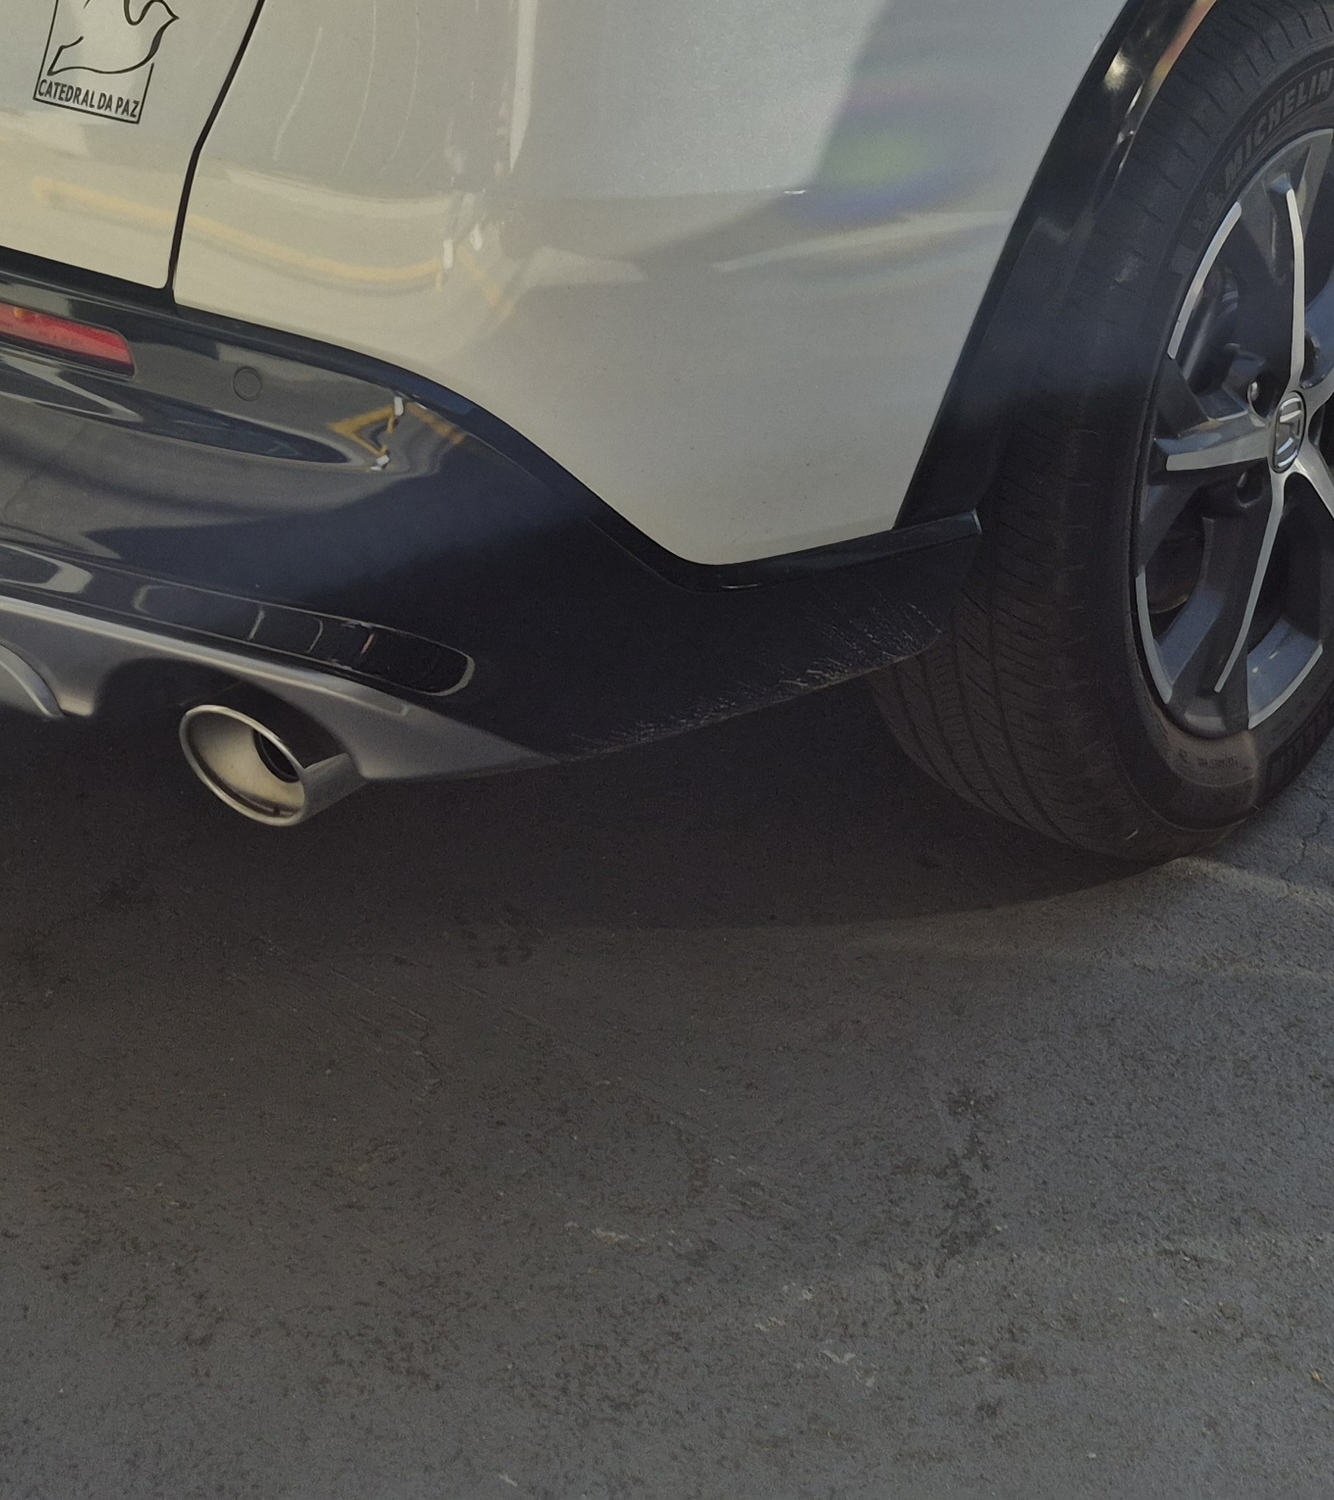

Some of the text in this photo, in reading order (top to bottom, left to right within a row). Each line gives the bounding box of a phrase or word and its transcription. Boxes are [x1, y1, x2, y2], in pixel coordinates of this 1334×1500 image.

[37, 78, 140, 119] CATEDRAL DA PAZ
[1224, 66, 1334, 192] MICHELIN
